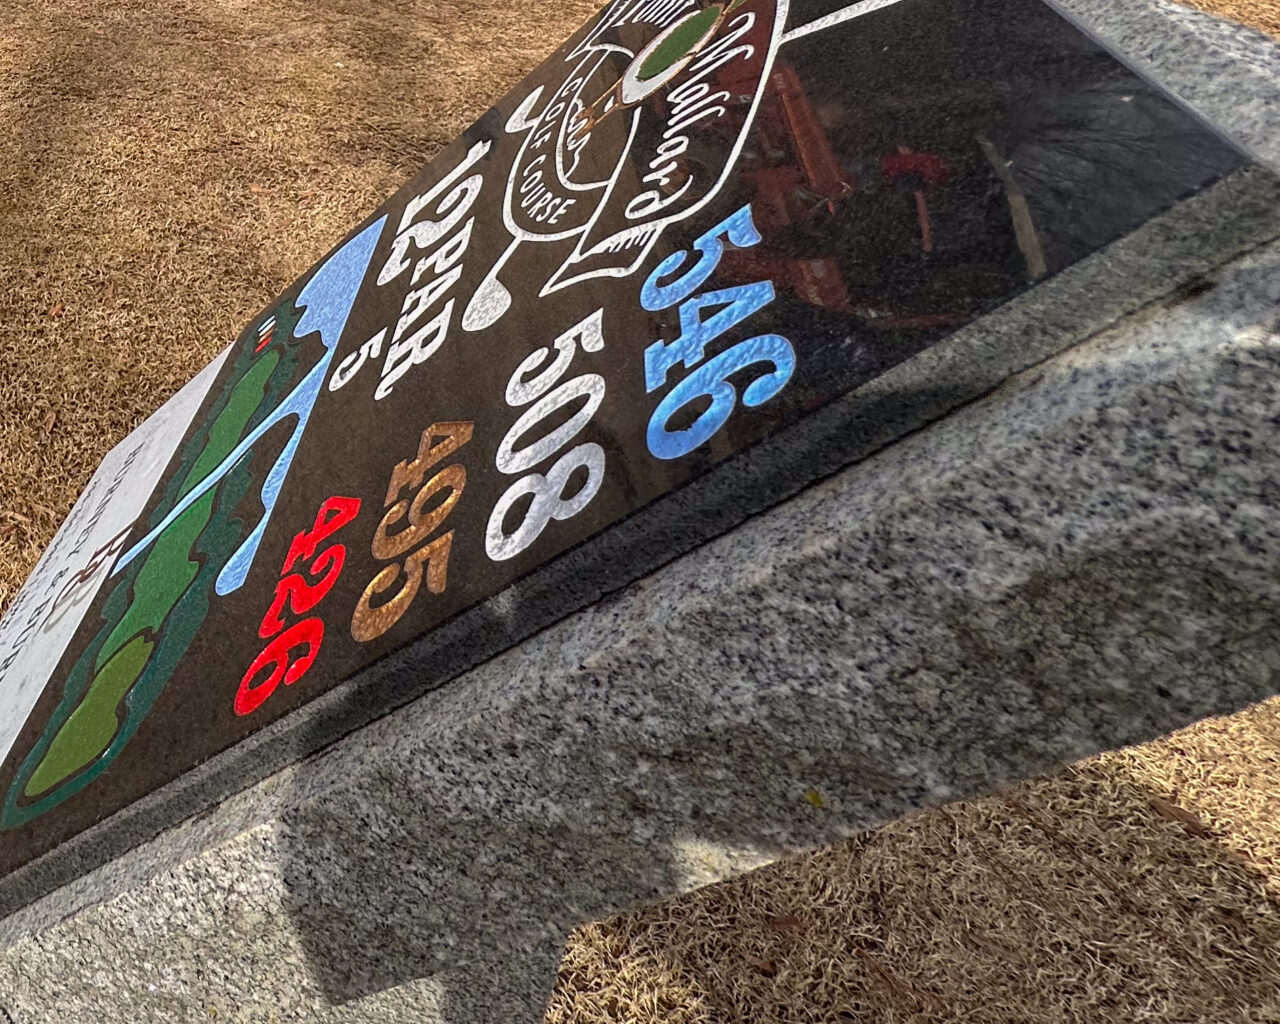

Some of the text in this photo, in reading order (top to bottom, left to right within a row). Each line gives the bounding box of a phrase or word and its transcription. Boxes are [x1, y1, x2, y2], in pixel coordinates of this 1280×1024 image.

[376, 139, 494, 286] 12
[520, 77, 584, 224] GOLF COURSE
[624, 11, 756, 220] Mallard
[328, 326, 381, 392] 5
[373, 217, 475, 400] PAR
[639, 203, 797, 461] 546
[350, 420, 475, 643] 495
[484, 307, 607, 562] 508
[232, 495, 362, 717] 426
